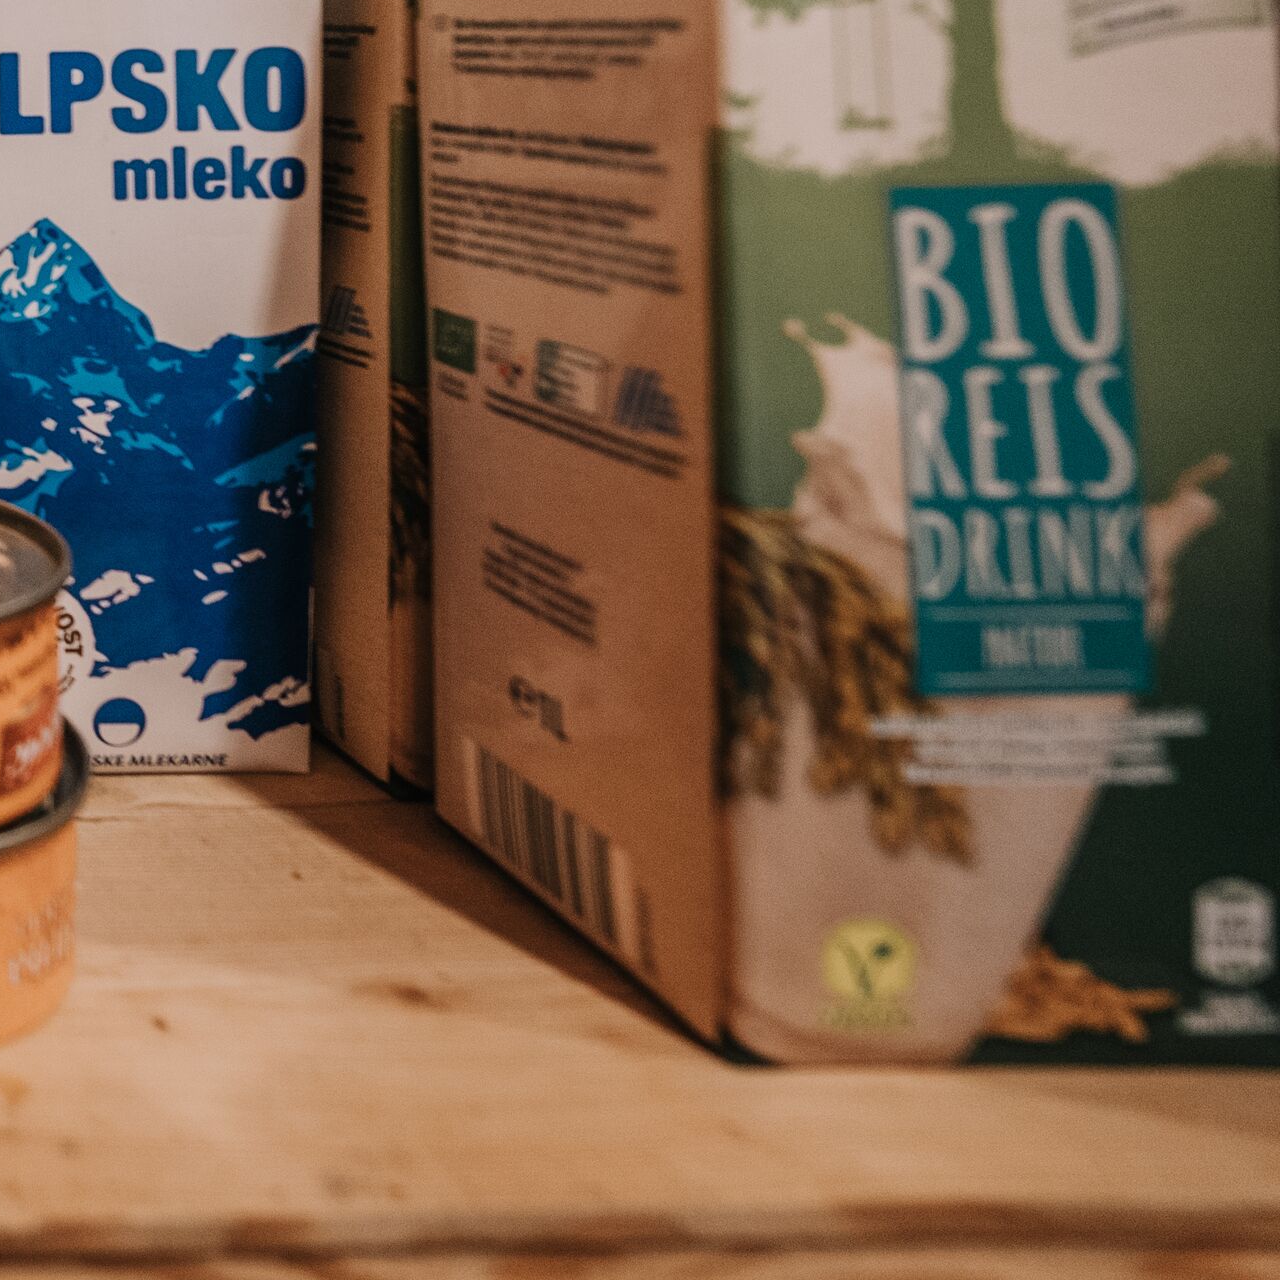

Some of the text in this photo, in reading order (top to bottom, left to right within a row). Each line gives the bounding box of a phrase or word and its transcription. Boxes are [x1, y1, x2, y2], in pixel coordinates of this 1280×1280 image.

[112, 143, 306, 201] mleko
[892, 196, 1124, 365] BIO
[902, 363, 1138, 502] REIS
[909, 504, 1148, 601] DRINK
[57, 606, 84, 658] OST
[91, 753, 228, 767] SKE MLEKARNE
